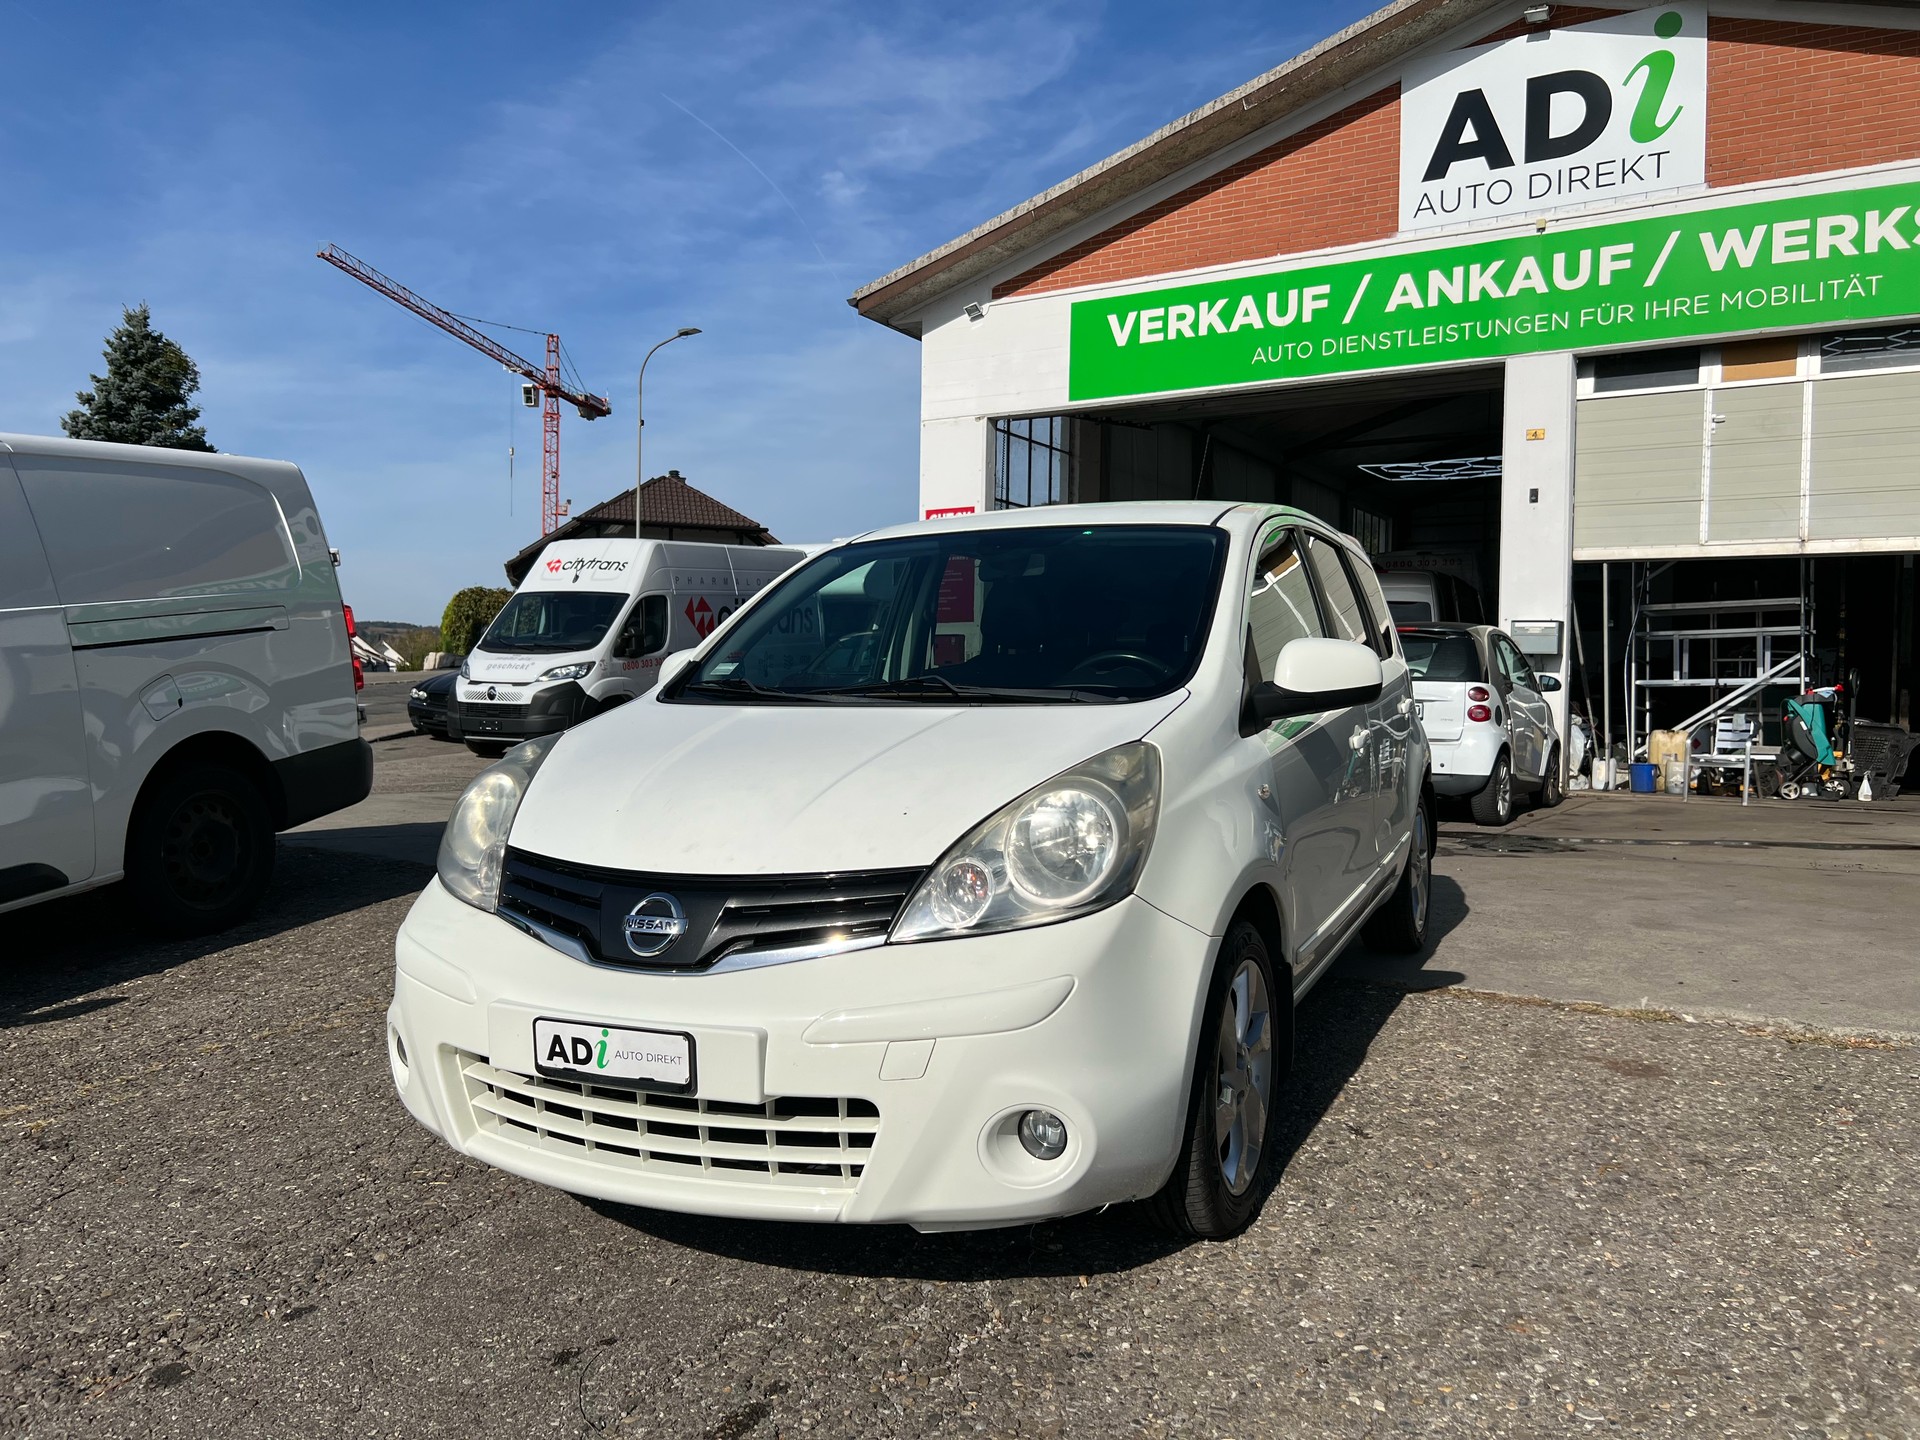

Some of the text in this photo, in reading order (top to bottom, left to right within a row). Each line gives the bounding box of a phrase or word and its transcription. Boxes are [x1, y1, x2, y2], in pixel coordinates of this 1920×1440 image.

[1413, 151, 1670, 219] AUTO DIREKT
[1106, 284, 1331, 347] VERKAUF
[1384, 242, 1634, 313] ANKAUF
[1698, 205, 1920, 272] WERK
[1251, 273, 1884, 365] AUTO DIENSTLEISTUNGEN FÜR IHRE MOBILITÄT
[562, 557, 629, 572] citytrans
[622, 660, 640, 671] 0800
[640, 658, 653, 668] 303
[625, 916, 678, 931] NISSAN
[614, 1049, 643, 1063] AUTO
[646, 1052, 683, 1066] DIREKT
